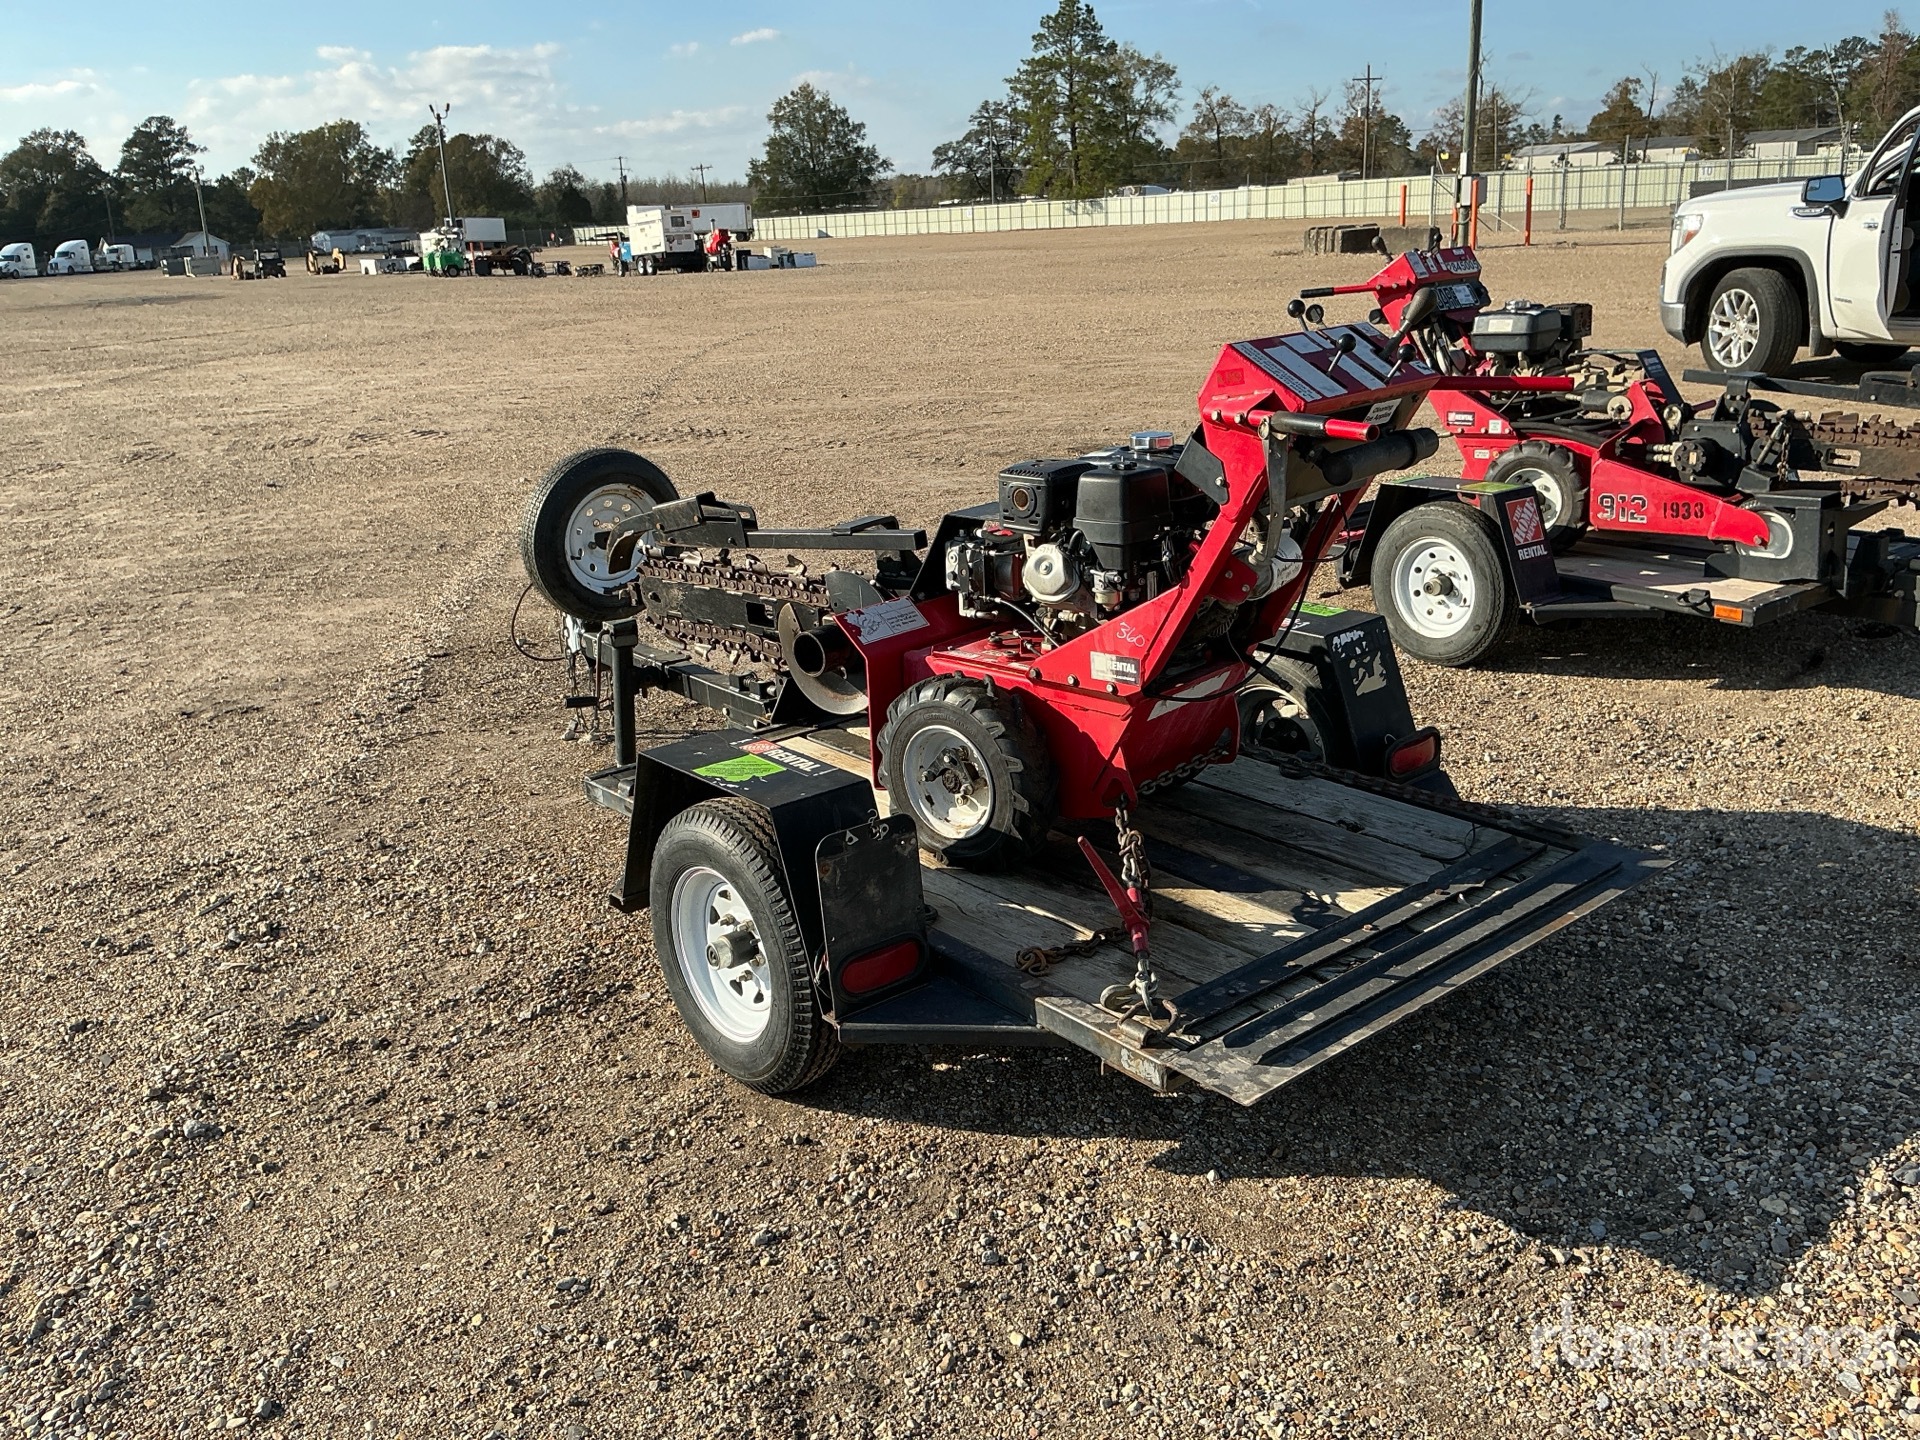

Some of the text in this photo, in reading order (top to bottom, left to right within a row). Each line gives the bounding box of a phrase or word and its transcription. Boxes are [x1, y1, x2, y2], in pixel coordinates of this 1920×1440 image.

[1513, 498, 1537, 544] HOME
[1597, 493, 1648, 524] 912
[1517, 544, 1548, 561] RENTAL
[1116, 621, 1146, 647] 360
[763, 748, 821, 772] RENTAL
